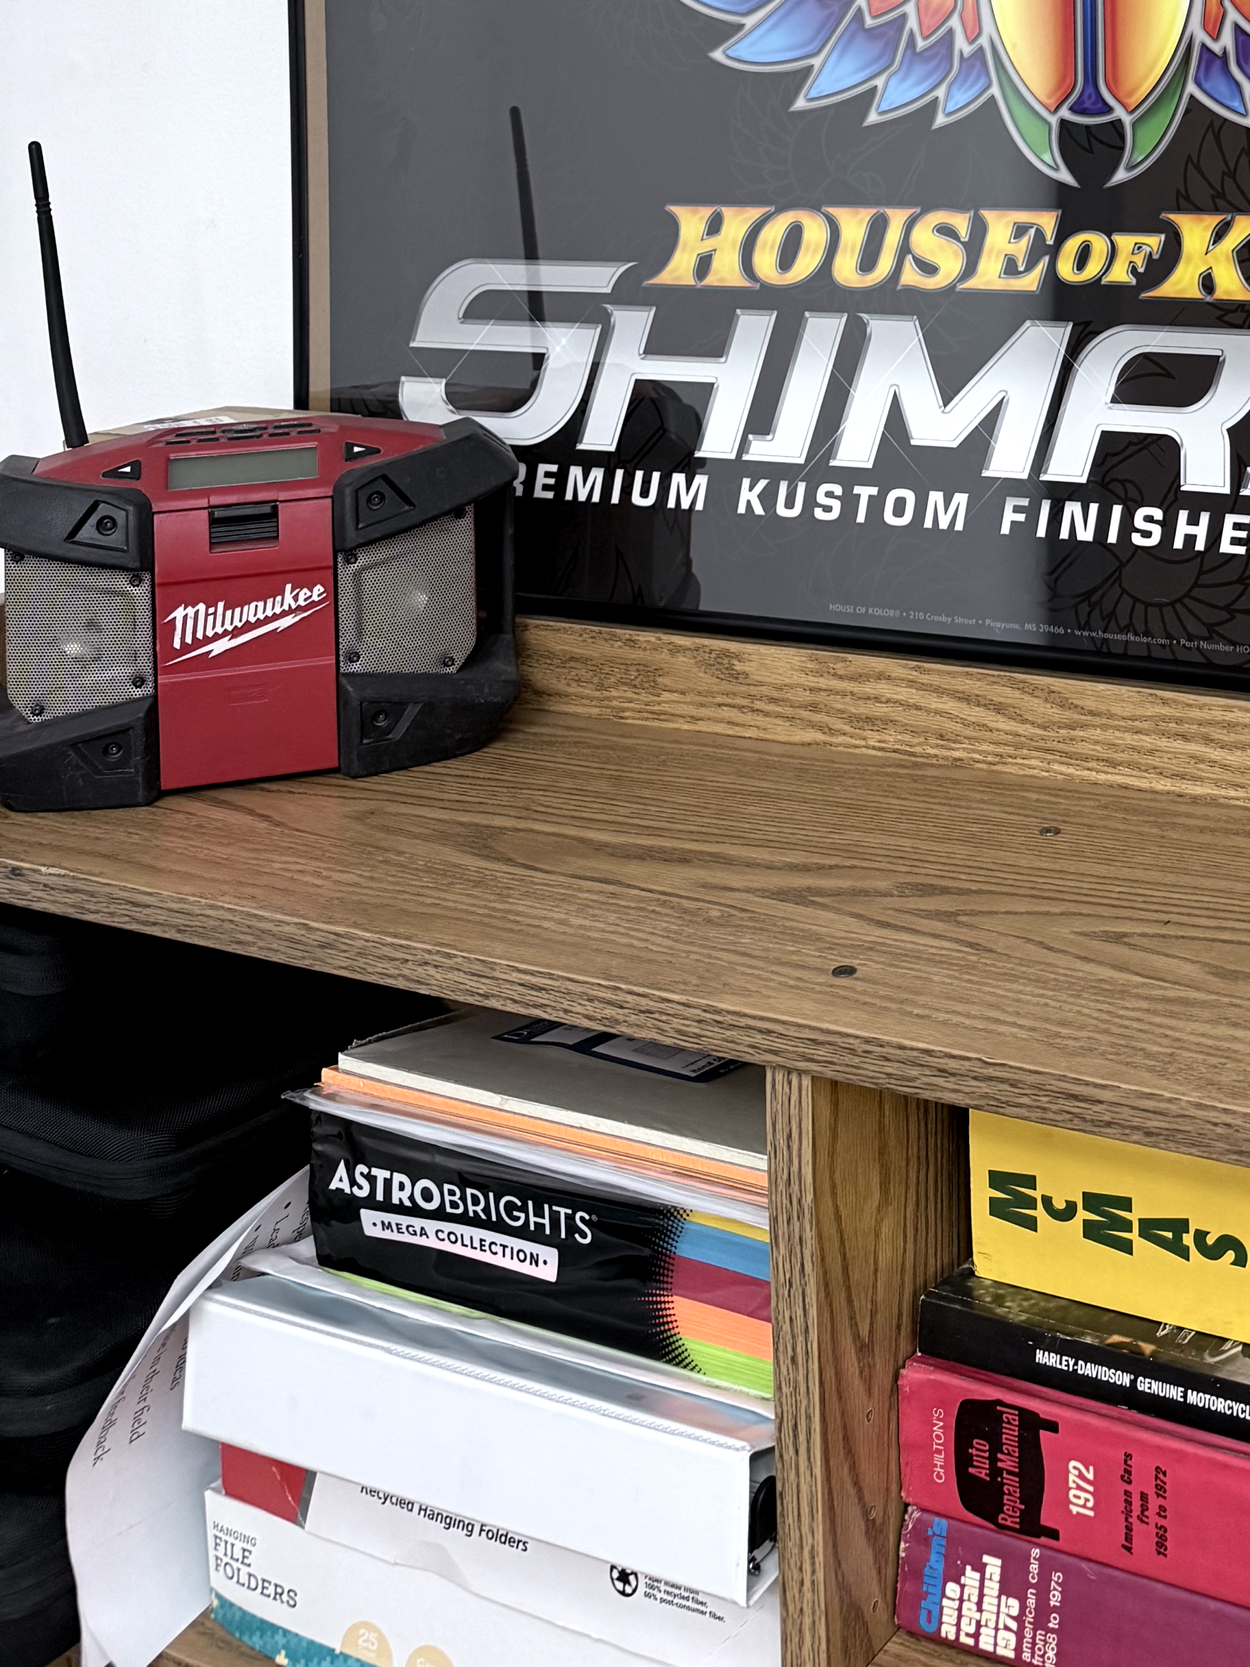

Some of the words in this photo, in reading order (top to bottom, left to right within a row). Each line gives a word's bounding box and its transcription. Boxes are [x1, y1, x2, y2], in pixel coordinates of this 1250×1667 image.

[643, 203, 1060, 294] HOUSE
[1056, 231, 1167, 286] OF
[737, 478, 969, 532] KUSTOM
[161, 583, 327, 650] Milwaukee
[829, 603, 855, 614] HOUSE
[856, 606, 866, 614] OF
[909, 612, 924, 620] 210
[925, 613, 953, 625] Crosby
[954, 615, 976, 625] Street
[985, 619, 1022, 631] Picayune,
[1024, 622, 1037, 631] MS
[1039, 624, 1065, 634] 39466
[1074, 628, 1170, 646] www.houseofkolor.com
[1180, 639, 1197, 648] Part
[1200, 640, 1234, 652] Number
[381, 1219, 430, 1239] MEGA
[435, 1228, 540, 1268] COLLECTION
[1137, 1377, 1184, 1402] GENUINE
[129, 1405, 150, 1444] field
[932, 1407, 945, 1483] CHILTON'S
[996, 1406, 1019, 1472] Manual
[968, 1439, 990, 1481] Auto
[1119, 1451, 1133, 1485] Cars
[1155, 1465, 1168, 1503] 1972
[998, 1472, 1025, 1529] Repair
[1068, 1460, 1095, 1517] 1972
[1139, 1491, 1150, 1526] from
[1155, 1504, 1168, 1520] to
[212, 1520, 257, 1548] HANGING
[417, 1504, 475, 1538] Hanging
[478, 1523, 529, 1552] Folders
[1120, 1489, 1133, 1555] American
[1155, 1523, 1168, 1559] 1965
[213, 1535, 253, 1567] FILE
[919, 1517, 948, 1634] Chilton's
[213, 1554, 299, 1609] FOLDERS
[959, 1564, 981, 1646] repair
[978, 1554, 1002, 1653] manual
[1021, 1588, 1037, 1663] american
[1029, 1547, 1041, 1584] cars
[1049, 1571, 1063, 1607] 1975
[940, 1581, 961, 1641] auto
[996, 1594, 1020, 1659] 1975
[1047, 1614, 1060, 1629] to
[357, 1629, 379, 1651] 25
[1032, 1630, 1046, 1667] from
